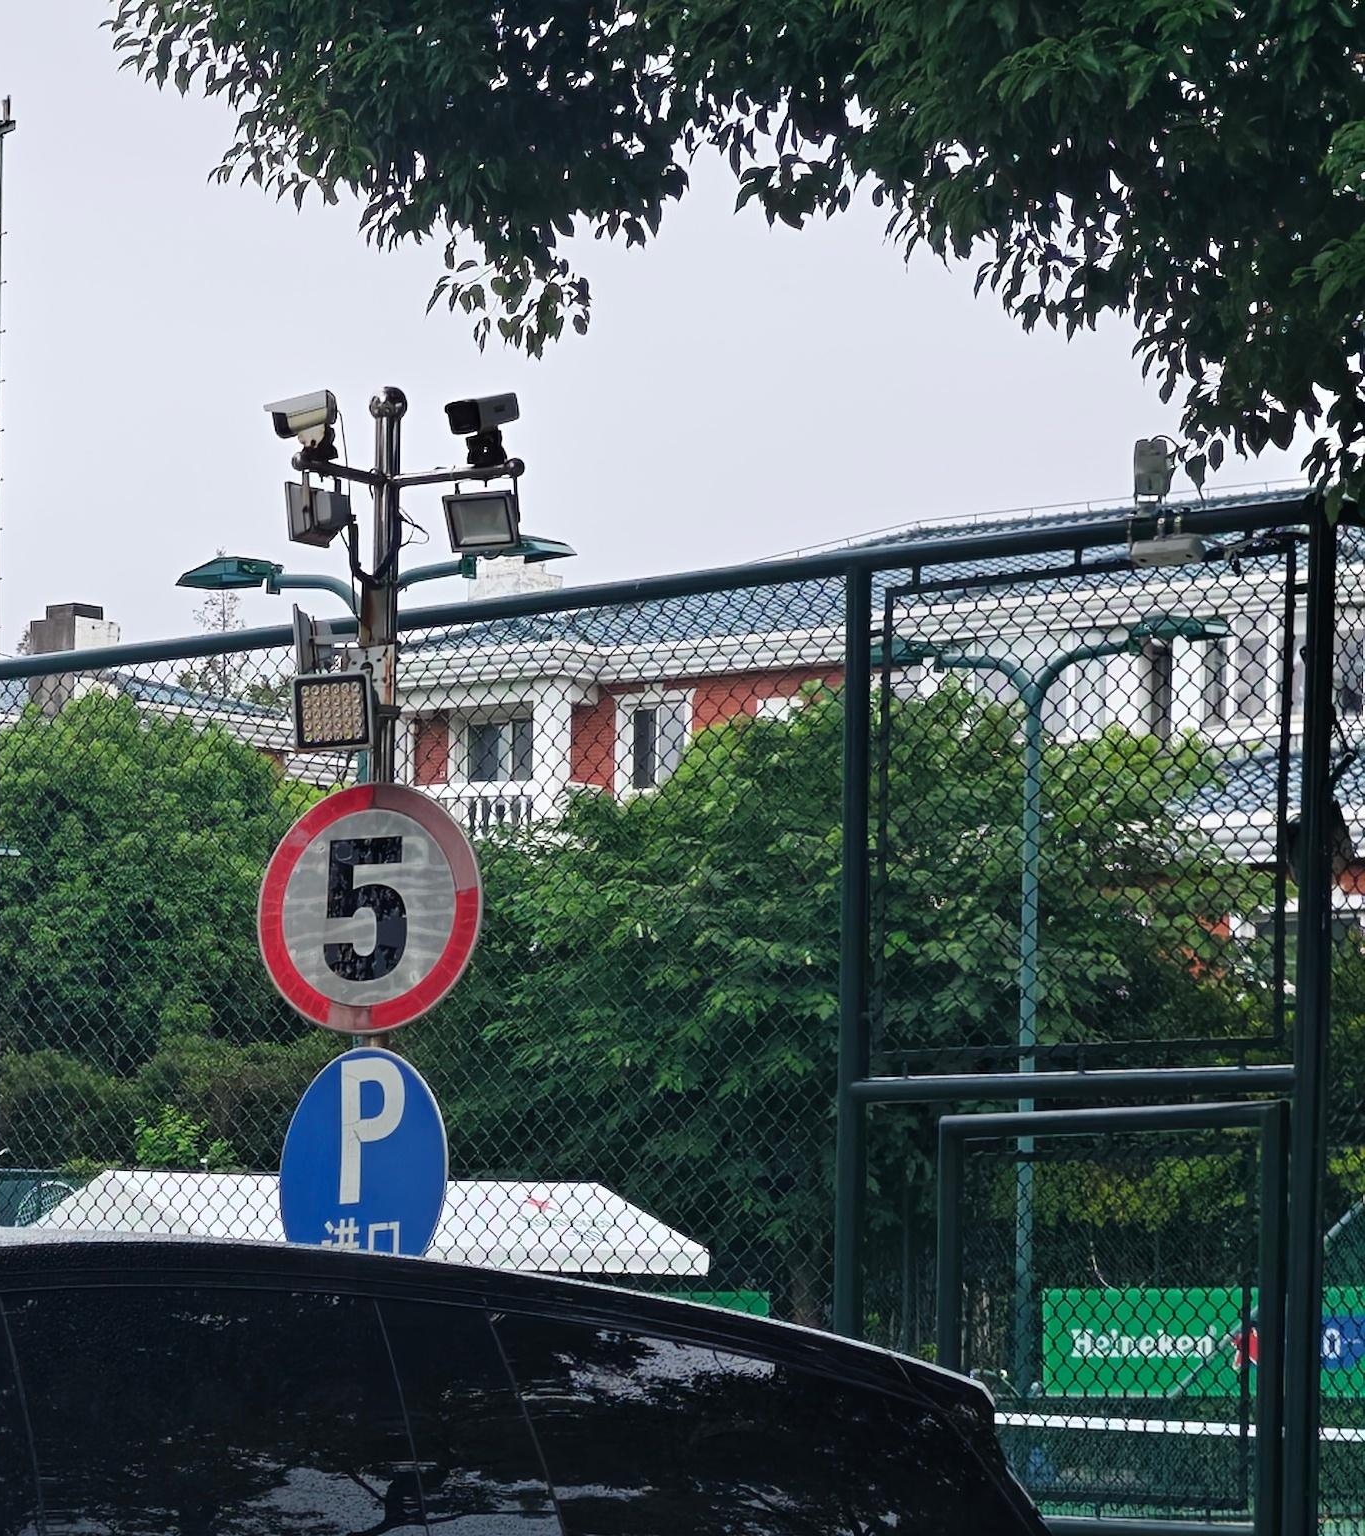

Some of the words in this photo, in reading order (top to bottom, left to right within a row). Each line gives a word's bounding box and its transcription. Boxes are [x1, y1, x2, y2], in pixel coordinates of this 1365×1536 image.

[322, 835, 408, 983] 5
[339, 1057, 405, 1205] P
[1071, 1328, 1213, 1358] Heineken
